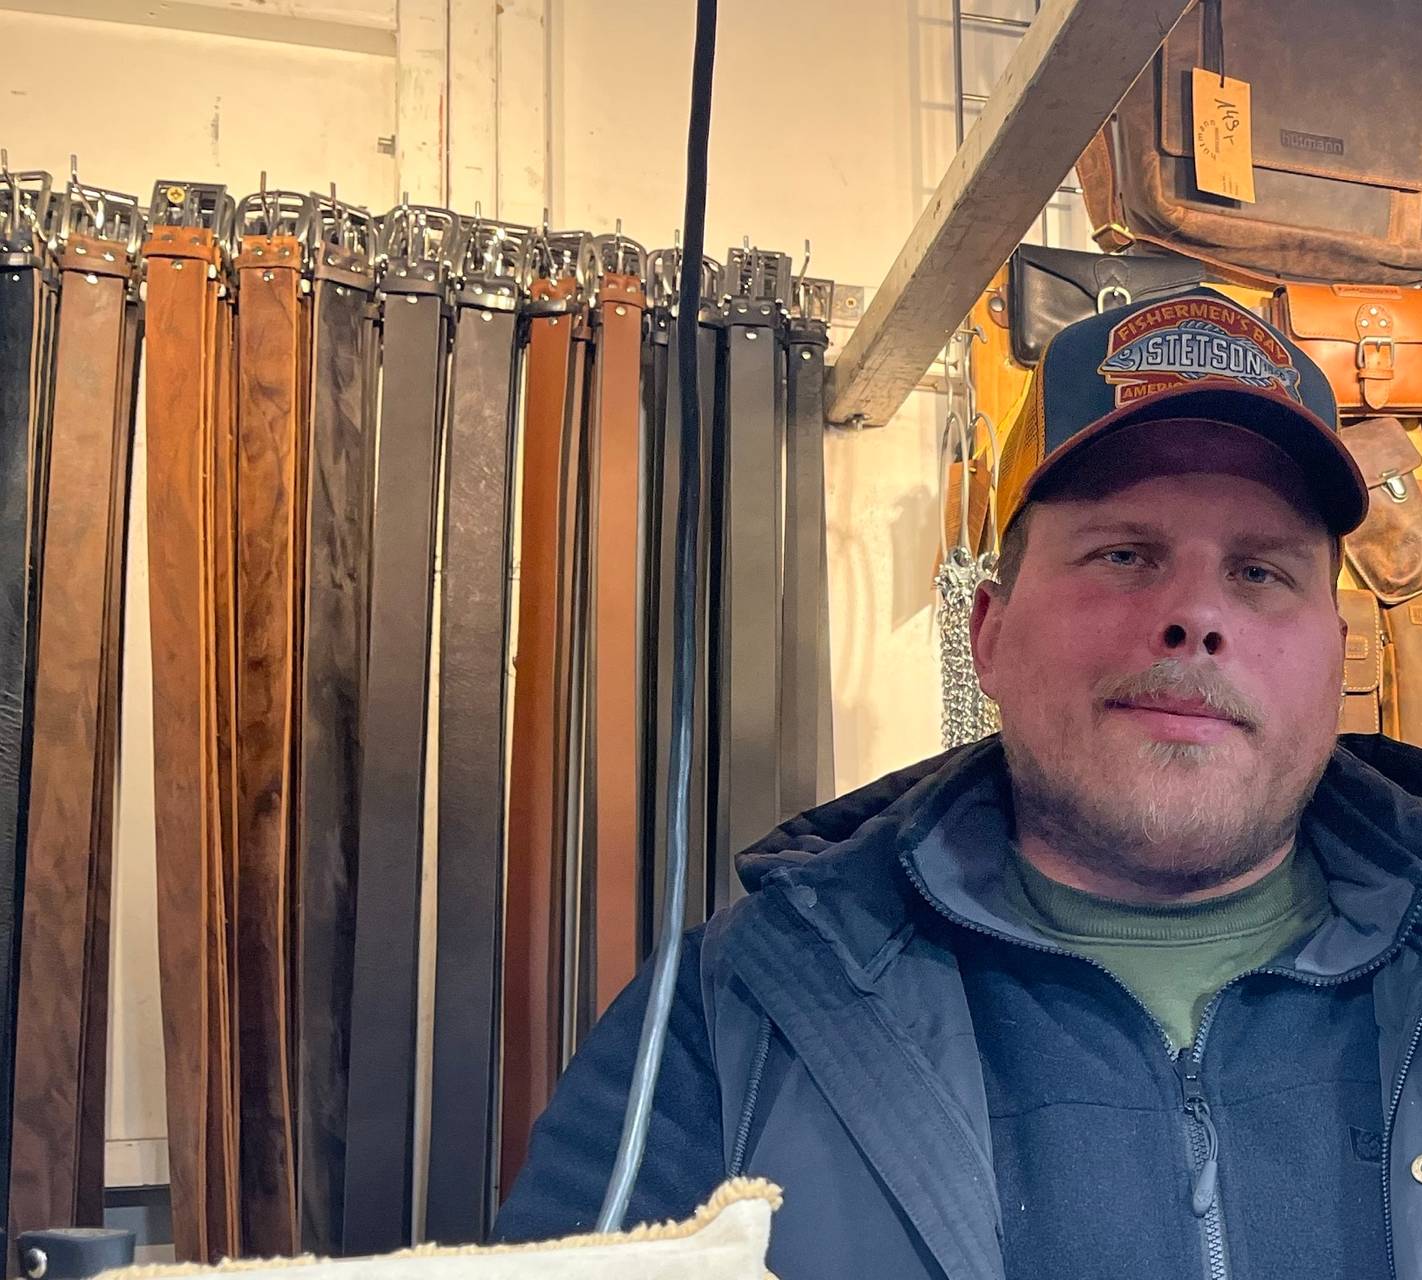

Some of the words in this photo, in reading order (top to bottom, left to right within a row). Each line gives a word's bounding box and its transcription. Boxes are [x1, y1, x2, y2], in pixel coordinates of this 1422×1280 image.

[1117, 303, 1249, 341] FISHERMEN'S
[1252, 330, 1288, 361] BAY
[1146, 333, 1263, 376] STETSON
